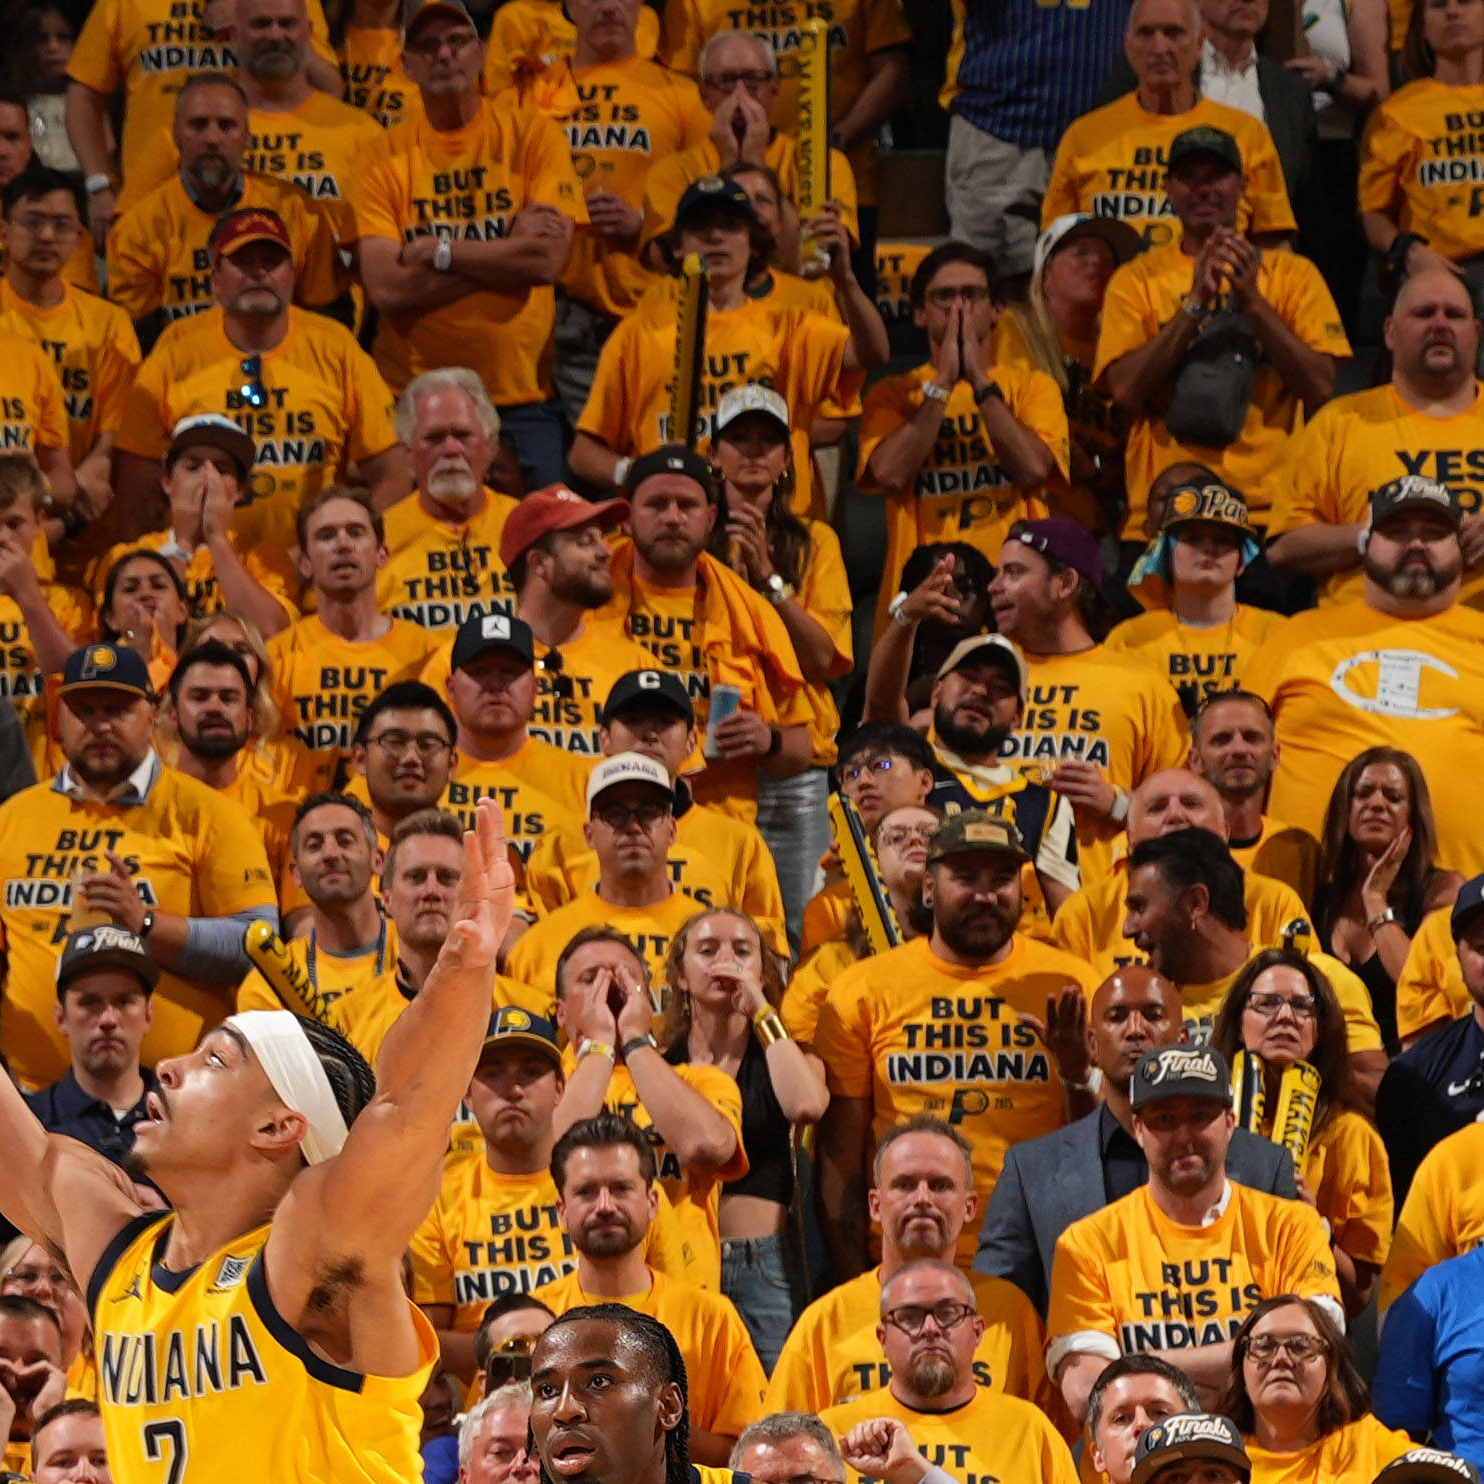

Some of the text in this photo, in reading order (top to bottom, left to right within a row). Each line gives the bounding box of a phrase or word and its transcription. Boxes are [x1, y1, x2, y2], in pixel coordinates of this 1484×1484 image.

[147, 17, 215, 42] THIS
[726, 4, 832, 30] THIS IS
[140, 45, 238, 74] INDIAN
[609, 103, 639, 121] IS
[299, 152, 324, 171] IS
[434, 168, 488, 192] BUT
[412, 189, 511, 219] THIS IS
[2, 398, 25, 420] IS
[286, 413, 313, 436] IS
[426, 545, 492, 572] BUT
[403, 571, 515, 600] THIS IS
[390, 602, 516, 630] INDIAN
[630, 614, 695, 639] BUT
[1168, 652, 1237, 675] BUT
[319, 667, 387, 690] BUT
[637, 670, 661, 689] C
[294, 694, 366, 720] THIS
[1067, 709, 1101, 733] IS
[447, 785, 518, 808] BUT
[512, 812, 544, 835] IS
[54, 830, 124, 851] BUT
[281, 958, 333, 1020] MAKE
[931, 997, 1006, 1021] BUT
[903, 1023, 1036, 1050] THIS IS
[887, 1053, 1050, 1084] INDIANA
[1158, 1050, 1218, 1085] Finals
[490, 1204, 559, 1236] BUT
[462, 1238, 558, 1266] THIS
[1162, 1257, 1232, 1286] BUT
[1135, 1284, 1265, 1318] THIS IS
[1121, 1320, 1242, 1353] INDIAN
[102, 1312, 267, 1407] NDIANA
[1163, 1414, 1234, 1447] Finals
[934, 1444, 971, 1468] UT
